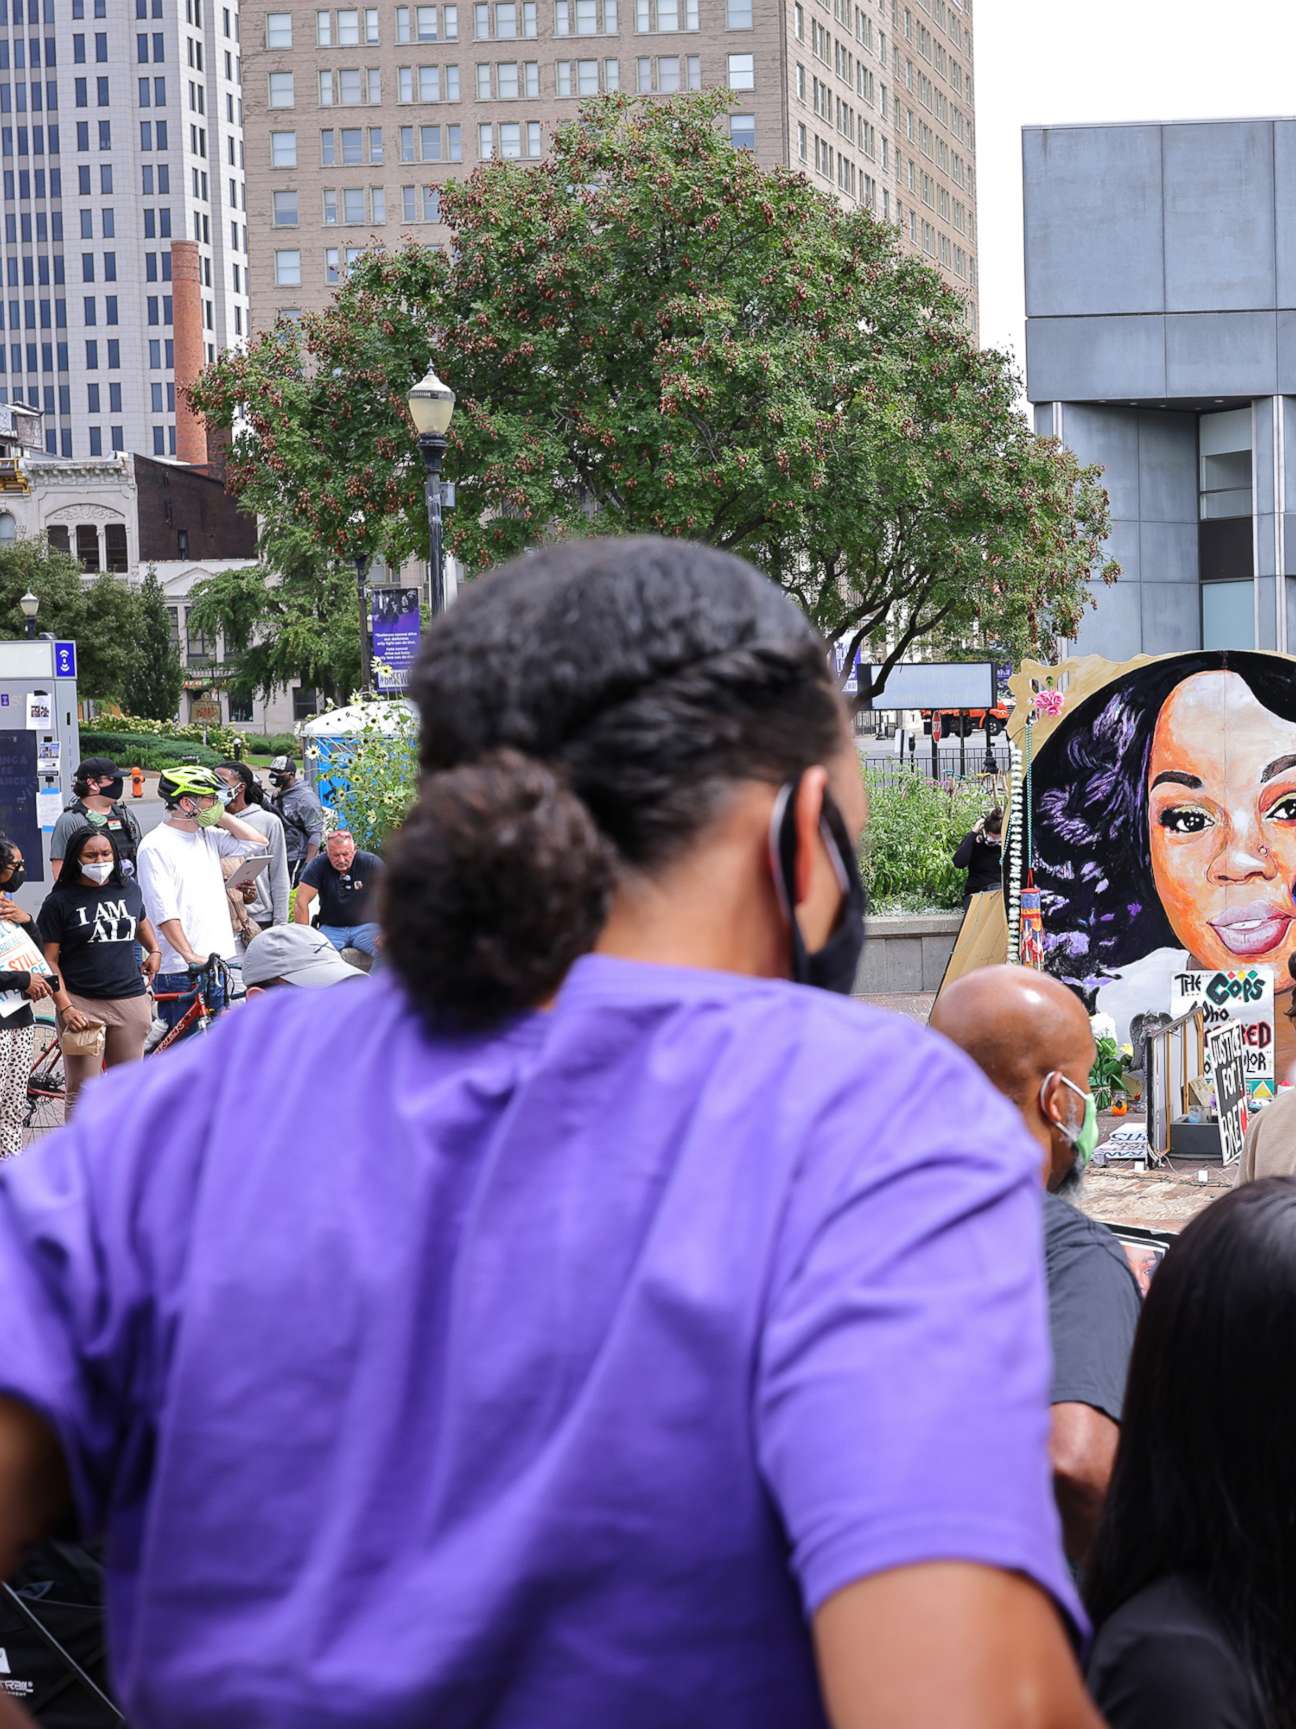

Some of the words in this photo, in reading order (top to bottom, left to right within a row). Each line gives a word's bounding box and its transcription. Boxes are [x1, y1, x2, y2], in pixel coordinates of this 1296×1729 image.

[76, 907, 90, 926] I
[93, 899, 130, 922] AM
[88, 916, 136, 943] ALI
[1174, 974, 1202, 996] THE
